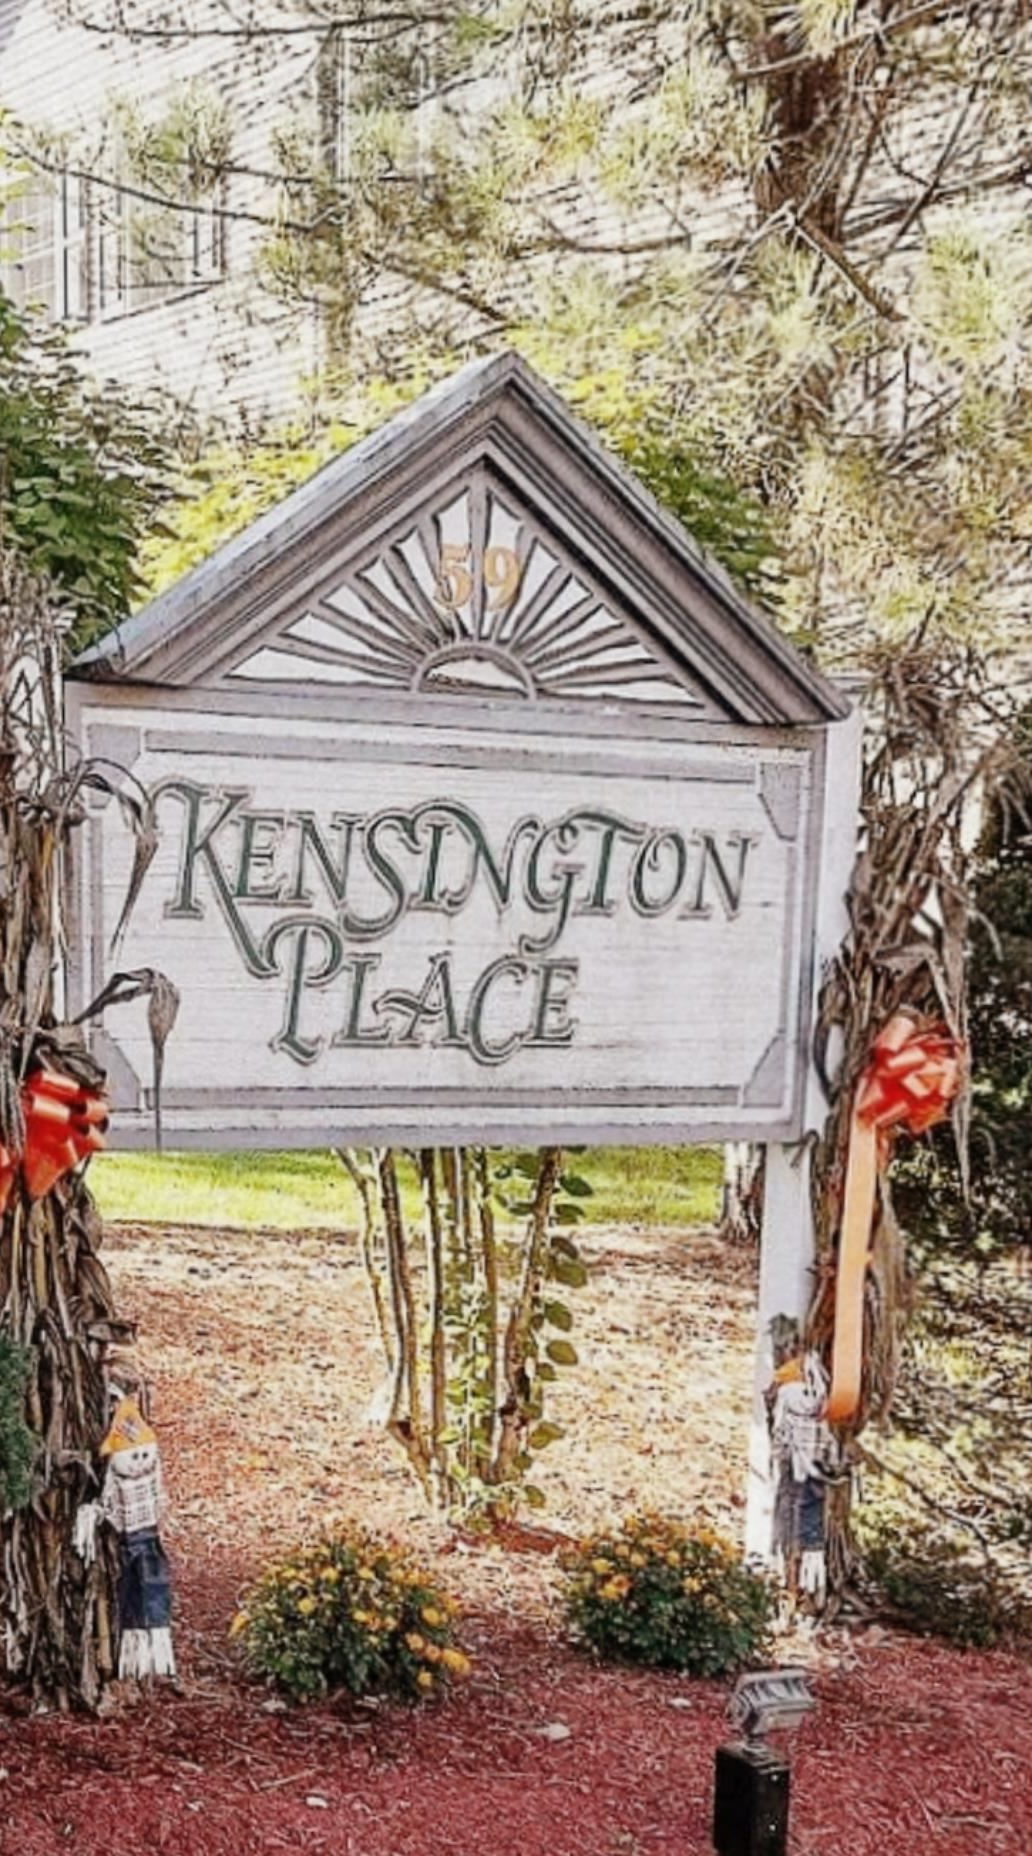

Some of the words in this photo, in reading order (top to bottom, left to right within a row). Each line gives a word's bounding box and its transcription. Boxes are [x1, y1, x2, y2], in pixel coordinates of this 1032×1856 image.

[434, 543, 519, 611] 59
[148, 776, 761, 979] KENSINGTON
[268, 914, 579, 1066] PLACE
